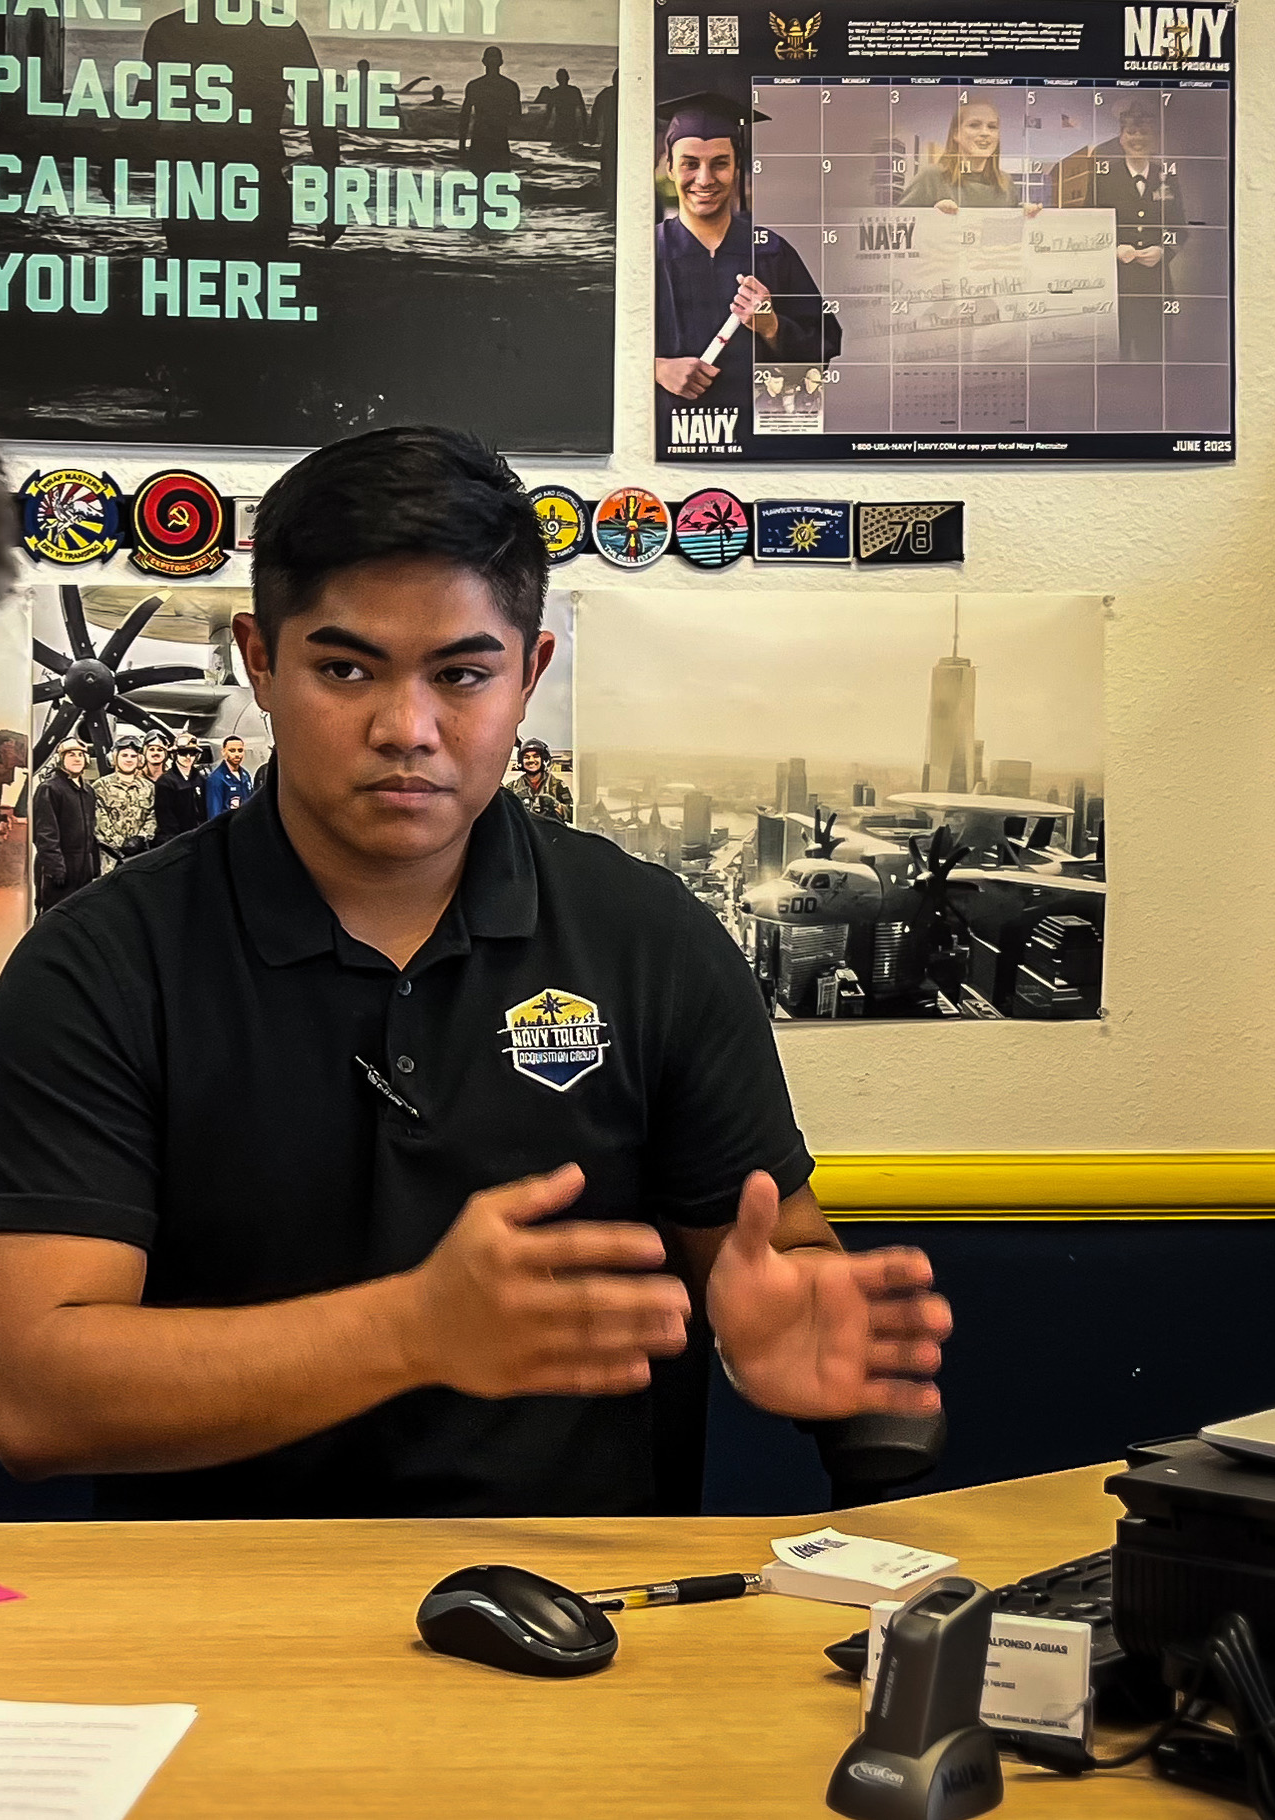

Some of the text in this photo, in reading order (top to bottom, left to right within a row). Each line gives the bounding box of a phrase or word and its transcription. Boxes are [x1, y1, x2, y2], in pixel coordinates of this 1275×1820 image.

[1124, 6, 1229, 58] NAVY
[1181, 61, 1230, 72] PROGRAMS
[283, 66, 401, 131] THE
[753, 91, 1172, 106] 1 2 3 4 5 6 7
[753, 161, 1176, 175] 8 9 10 11 12 13 14
[291, 164, 522, 231] BRINGS
[753, 231, 768, 244] 15
[823, 231, 837, 244] 16
[1163, 232, 1177, 245] 21
[141, 257, 318, 321] HERE.
[754, 301, 772, 314] 22
[823, 301, 840, 314] 23
[892, 301, 909, 314] 24
[960, 301, 976, 314] 25
[1163, 301, 1180, 314] 28
[754, 371, 840, 383] 29 30
[671, 414, 739, 444] NAVY
[1173, 440, 1232, 452] JUNE 2025
[888, 520, 933, 555] 78
[512, 1027, 600, 1047] NAVY TALENT
[988, 1636, 1031, 1650] ALFONSO
